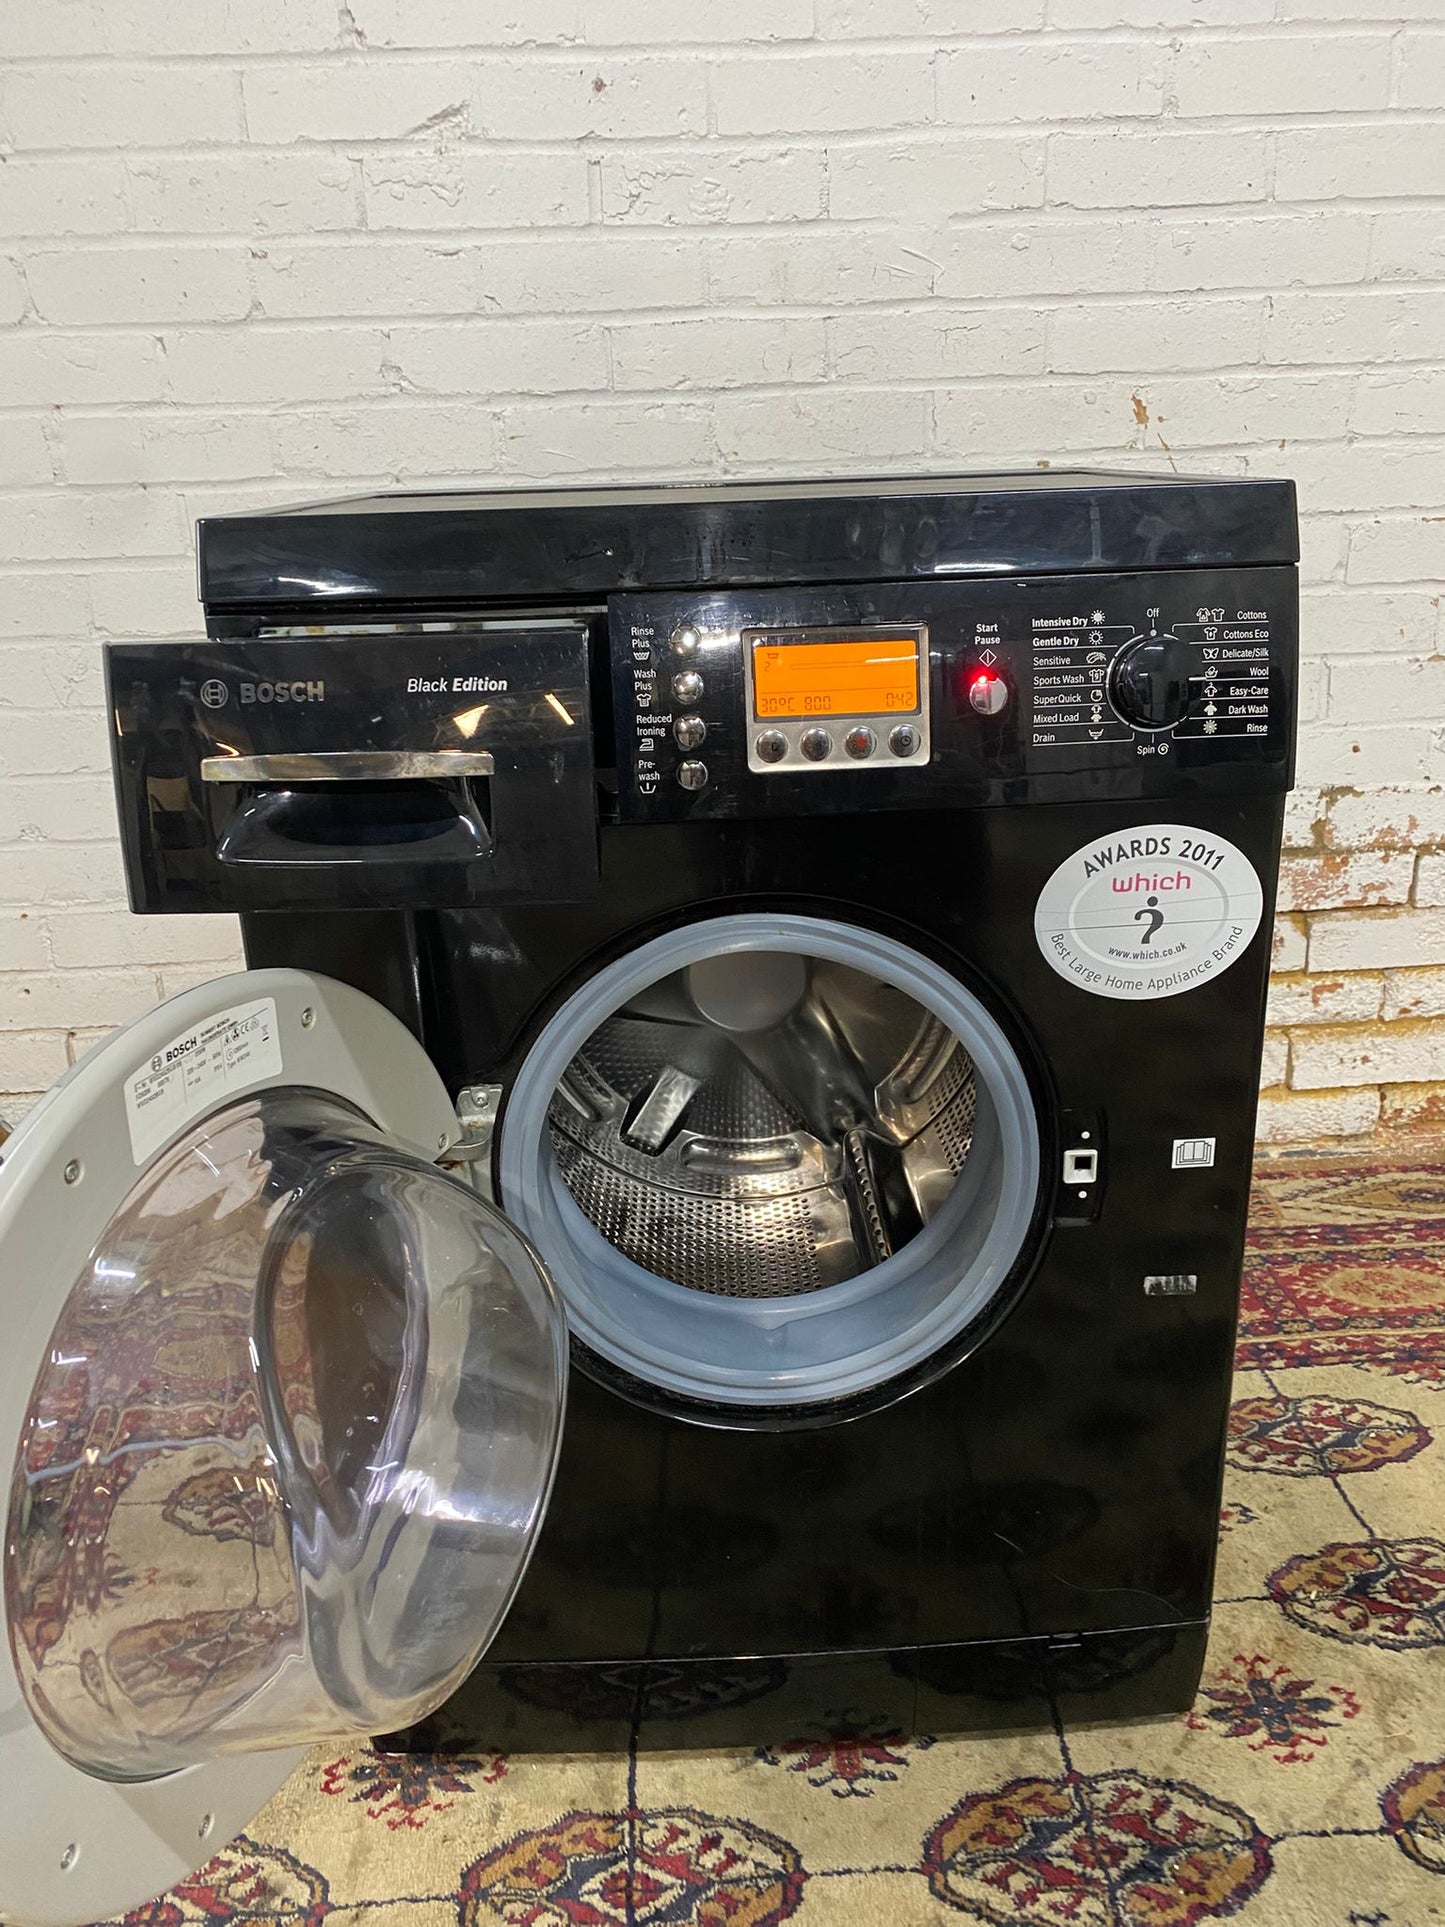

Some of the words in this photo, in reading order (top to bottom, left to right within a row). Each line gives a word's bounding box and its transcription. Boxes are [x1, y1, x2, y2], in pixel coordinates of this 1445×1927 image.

[1146, 608, 1160, 618] Off
[1237, 610, 1267, 620] Cottons
[1032, 618, 1070, 627] Intensive
[1072, 616, 1088, 627] Dry
[631, 626, 655, 636] Rinse
[976, 623, 998, 633] Start
[1223, 629, 1254, 639] Cottons
[1255, 628, 1269, 639] Eco
[632, 638, 650, 649] Plus
[974, 635, 1001, 645] Pause
[1033, 637, 1061, 647] Gentle
[1062, 636, 1079, 647] Dry
[1222, 647, 1269, 659] Delicate/Silk
[1033, 656, 1071, 666] Sensitive
[634, 669, 657, 679] Wash
[1249, 666, 1269, 677] Wool
[407, 677, 448, 693] Black
[452, 677, 508, 693] Edition
[634, 681, 653, 691] Plus
[1033, 676, 1061, 687] Sports
[1063, 674, 1084, 684] Wash
[240, 680, 325, 703] BOSCH
[804, 696, 831, 711] 800
[1033, 694, 1082, 705] SuperQuick
[1228, 705, 1247, 715] Dark
[1248, 704, 1269, 714] Wash
[636, 714, 672, 724] Reduced
[1033, 714, 1058, 724] Mixed
[1059, 713, 1080, 723] Load
[637, 727, 666, 737] Ironing
[1246, 723, 1268, 733] Rinse
[1033, 733, 1056, 743] Drain
[1137, 745, 1155, 756] Spin
[638, 760, 656, 769] Pre-
[638, 771, 660, 781] wash
[1083, 837, 1171, 878] AWARDS
[1179, 839, 1225, 871] 2011
[1112, 871, 1191, 893] which
[1108, 942, 1187, 960] www.which.co.uk
[1051, 933, 1071, 961] Best
[1068, 957, 1102, 984] Large
[1104, 974, 1143, 991] Home
[1147, 959, 1213, 991] Appliance
[1212, 926, 1243, 961] Brand
[166, 1037, 198, 1062] BOSCH
